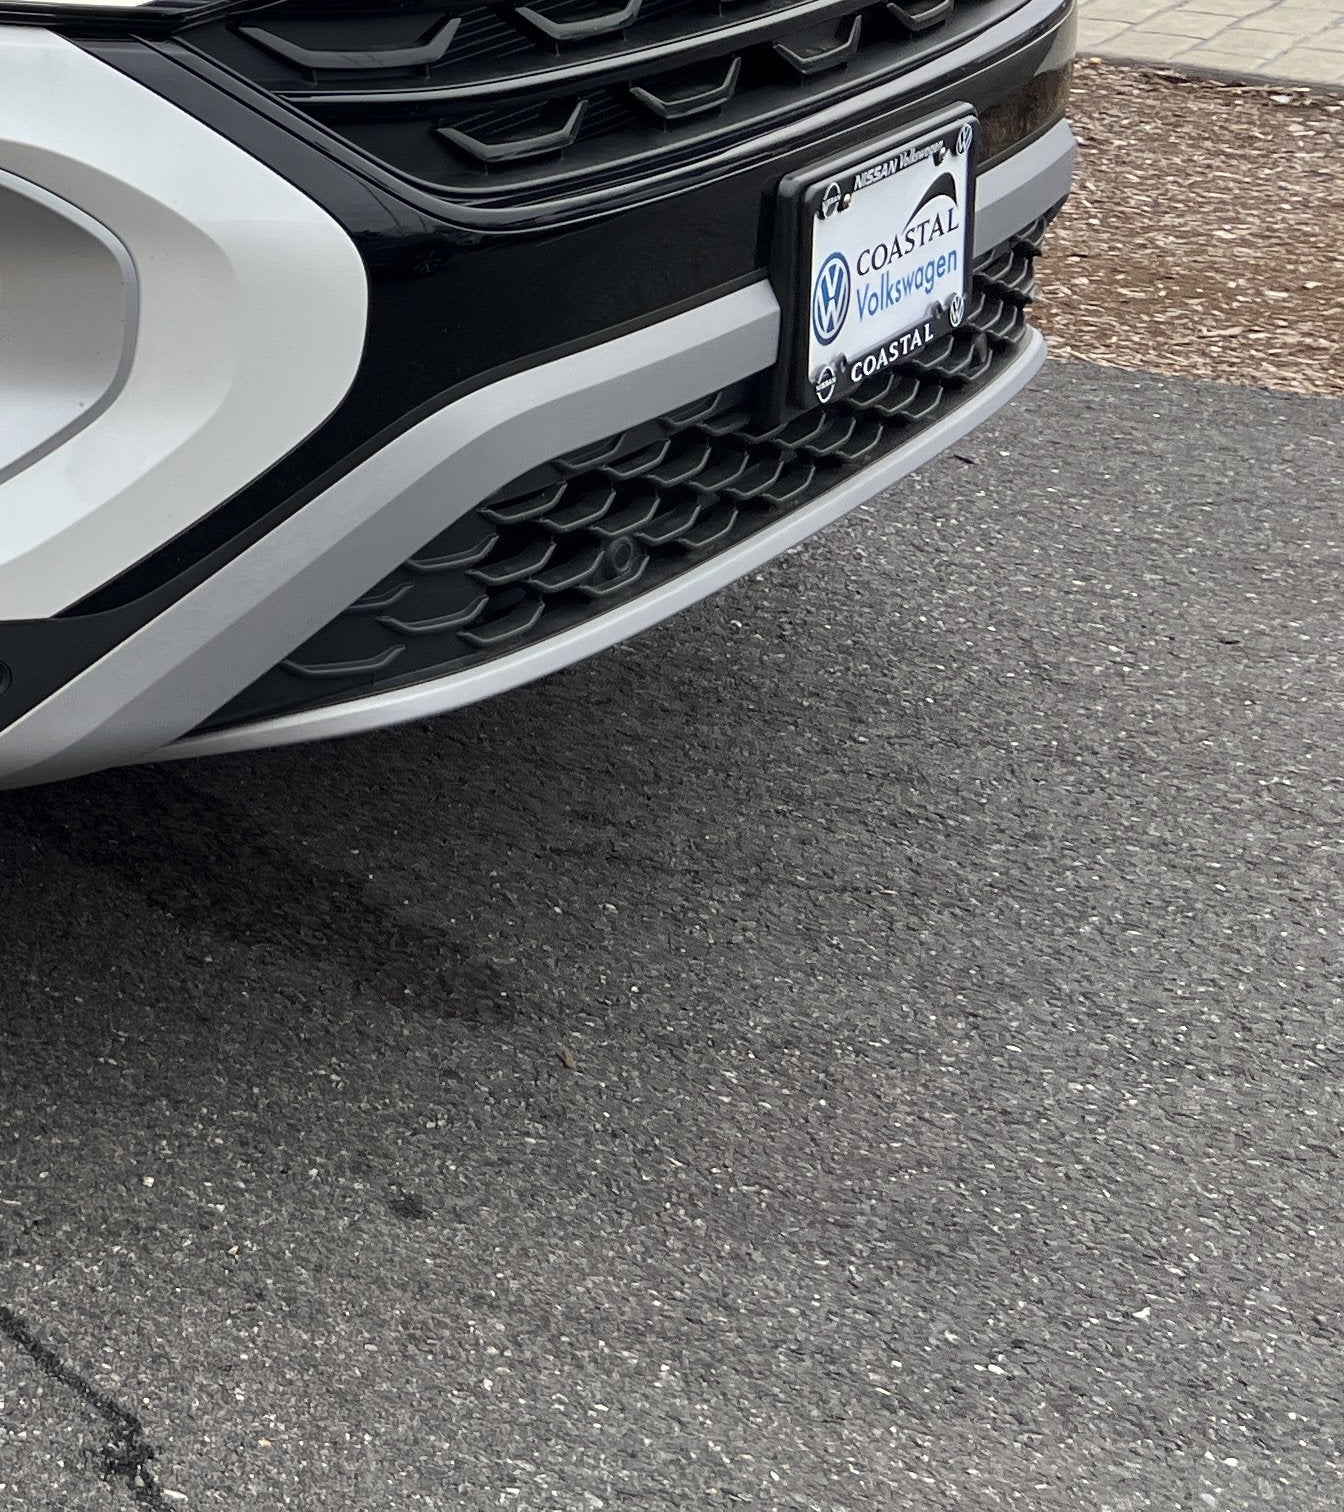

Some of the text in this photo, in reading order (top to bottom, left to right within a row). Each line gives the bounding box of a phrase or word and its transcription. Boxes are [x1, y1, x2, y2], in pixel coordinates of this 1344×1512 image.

[853, 159, 899, 191] NISSAN
[856, 207, 959, 276] COASTAL
[814, 255, 849, 340] VW
[856, 249, 958, 322] Volkswagen
[851, 323, 934, 382] COASTAL
